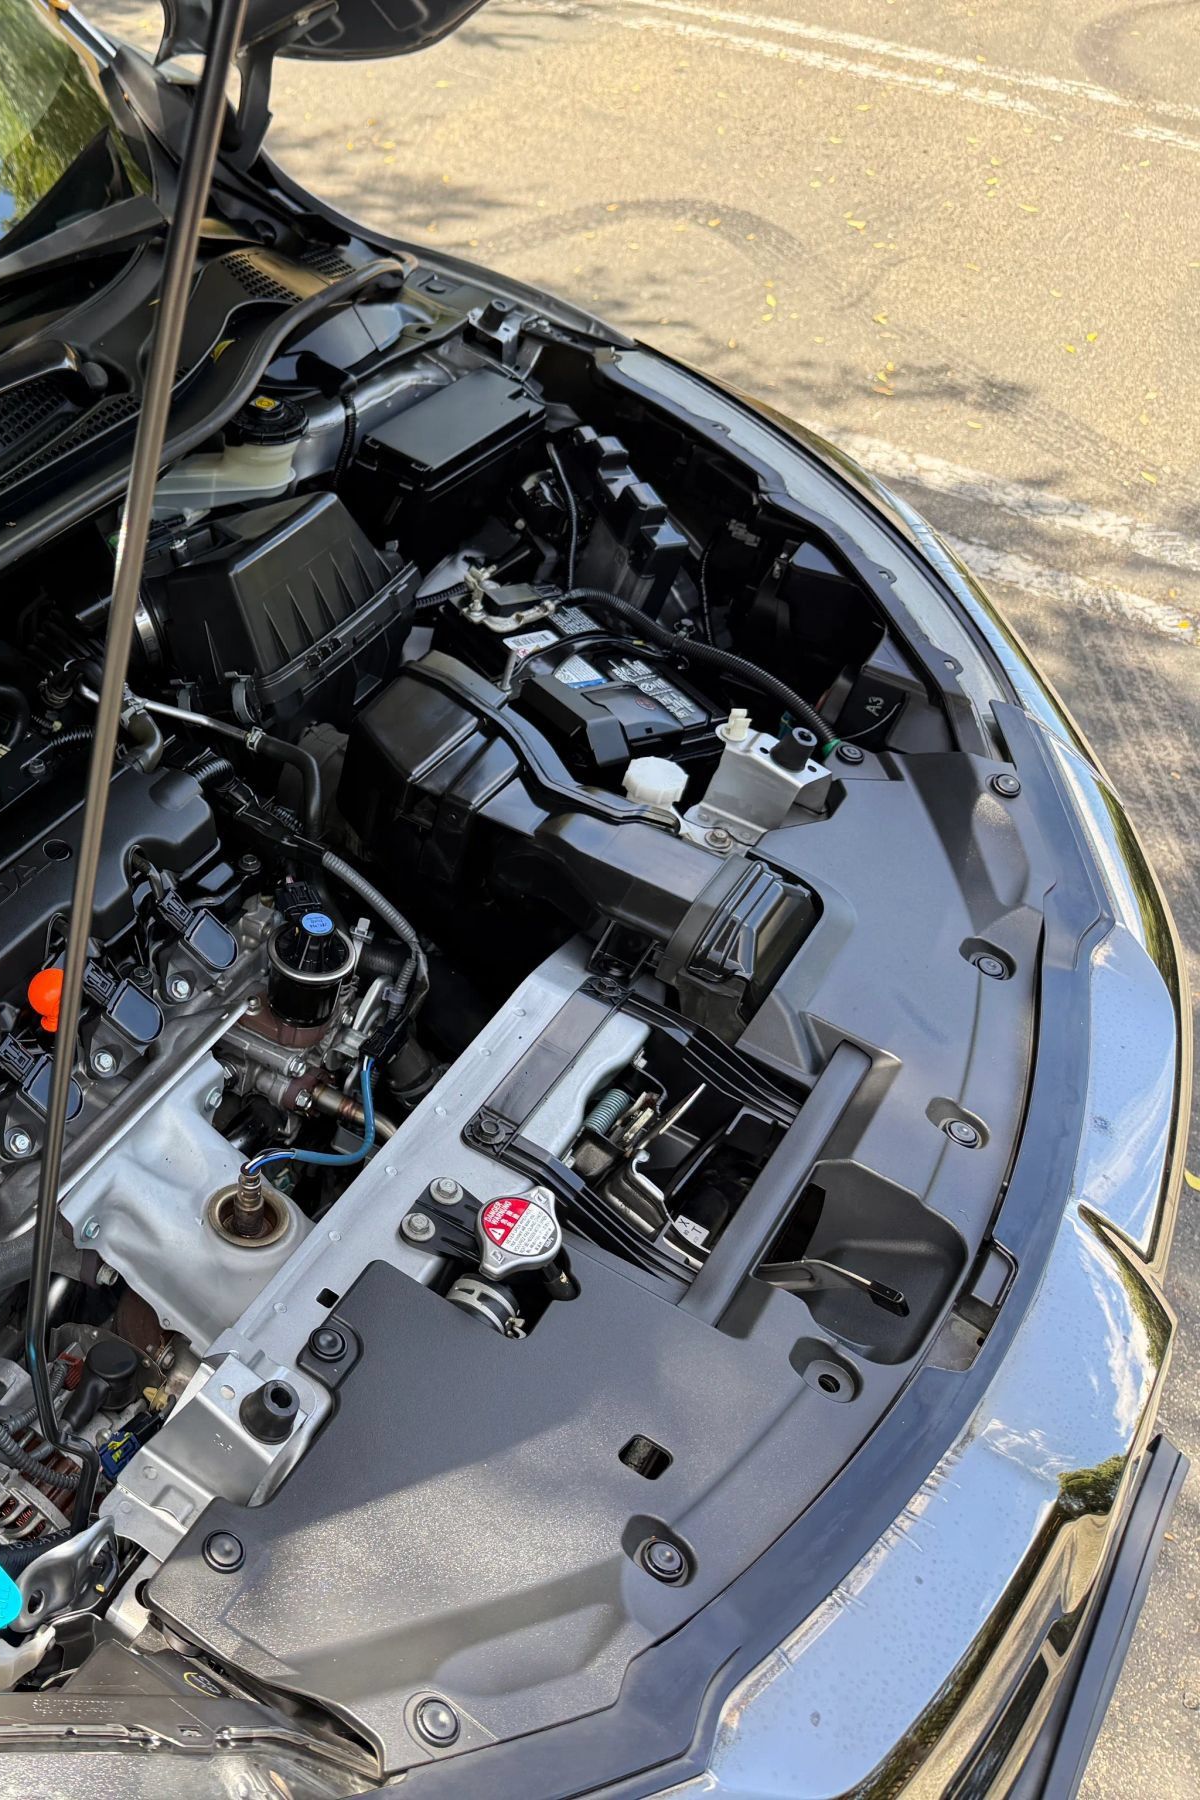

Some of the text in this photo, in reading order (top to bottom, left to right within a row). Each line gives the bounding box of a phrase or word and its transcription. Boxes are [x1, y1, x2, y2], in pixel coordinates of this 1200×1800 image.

[864, 696, 884, 717] A3
[484, 1201, 501, 1222] DANGER
[490, 1200, 511, 1225] WARNING
